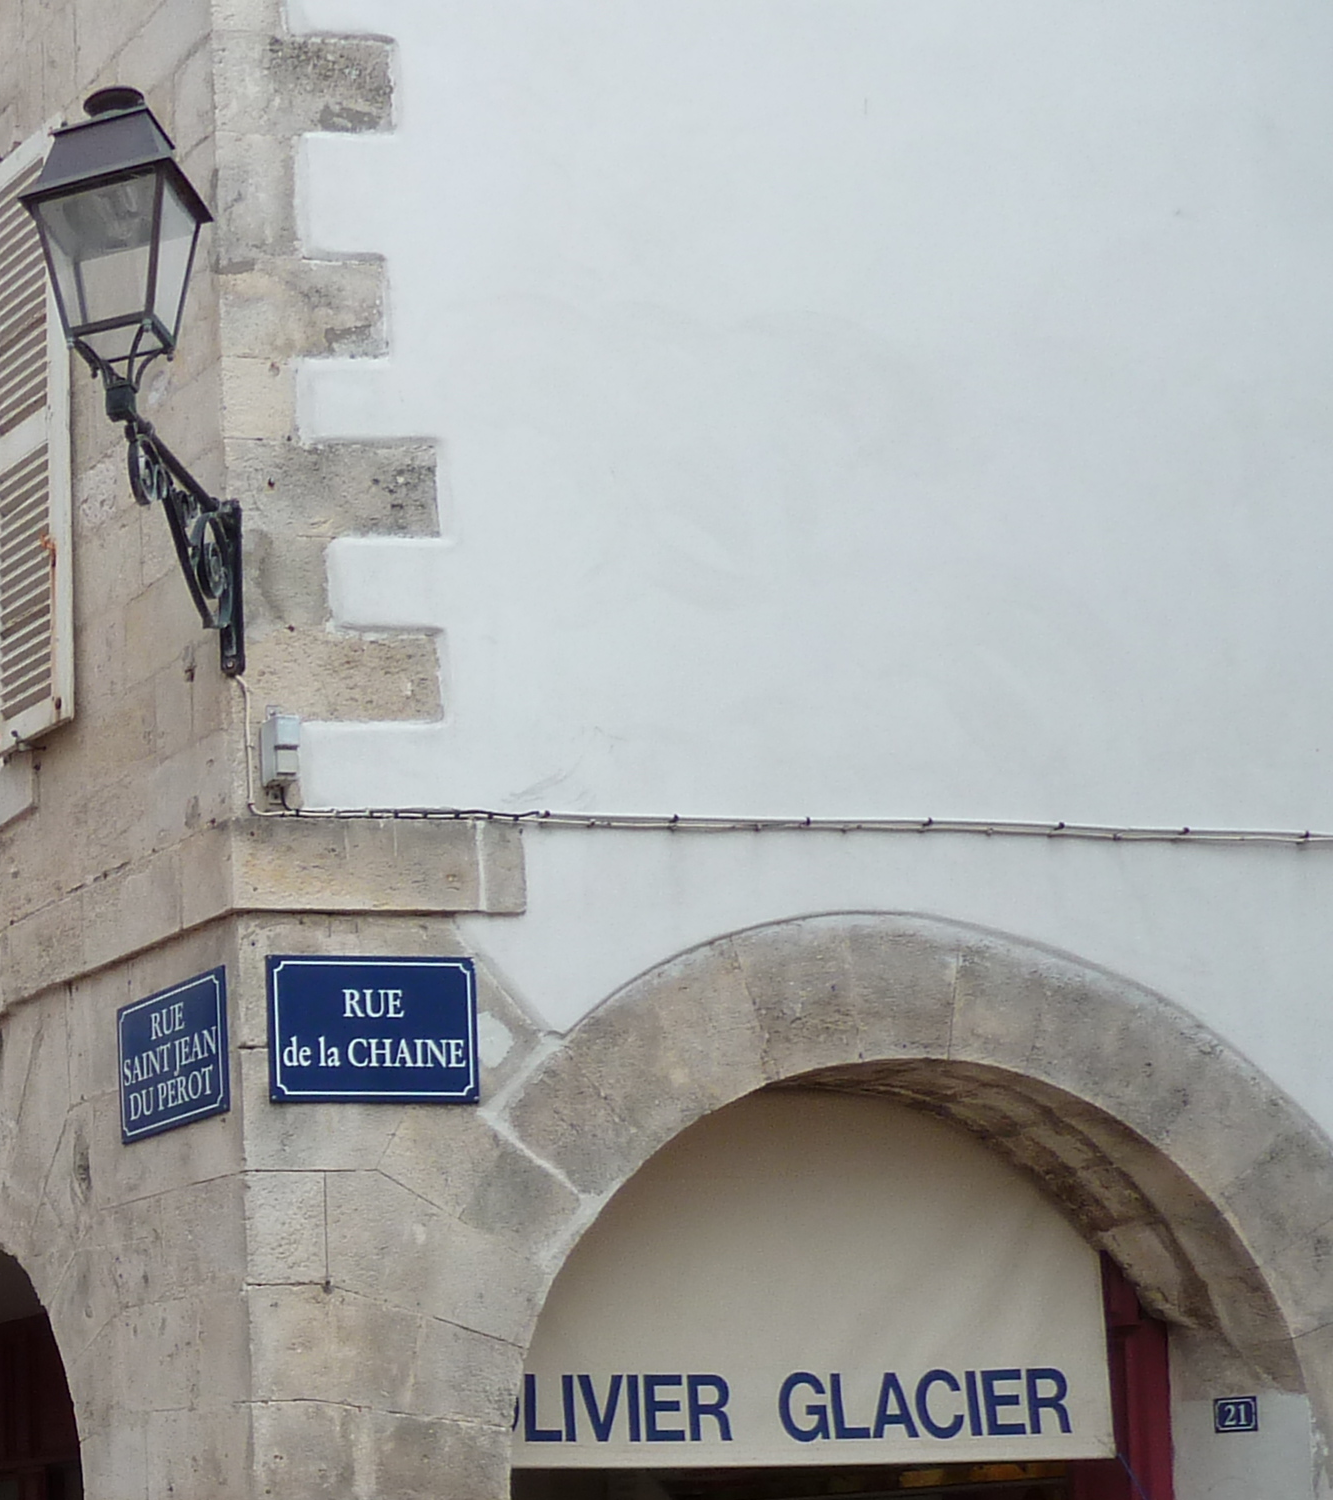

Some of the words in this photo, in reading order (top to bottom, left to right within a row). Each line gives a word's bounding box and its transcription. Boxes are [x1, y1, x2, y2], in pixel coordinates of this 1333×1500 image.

[150, 1001, 185, 1041] RUE
[341, 988, 405, 1018] RUE
[123, 1042, 171, 1087] SAINT
[173, 1025, 217, 1077] JEAN
[282, 1035, 312, 1067] de
[318, 1035, 341, 1067] la
[347, 1038, 467, 1068] CHAINE
[129, 1087, 154, 1121] DU
[157, 1064, 214, 1112] PEROT
[512, 1373, 733, 1443] LIVIER
[778, 1367, 1073, 1443] GLACIER
[1224, 1403, 1248, 1426] 21
